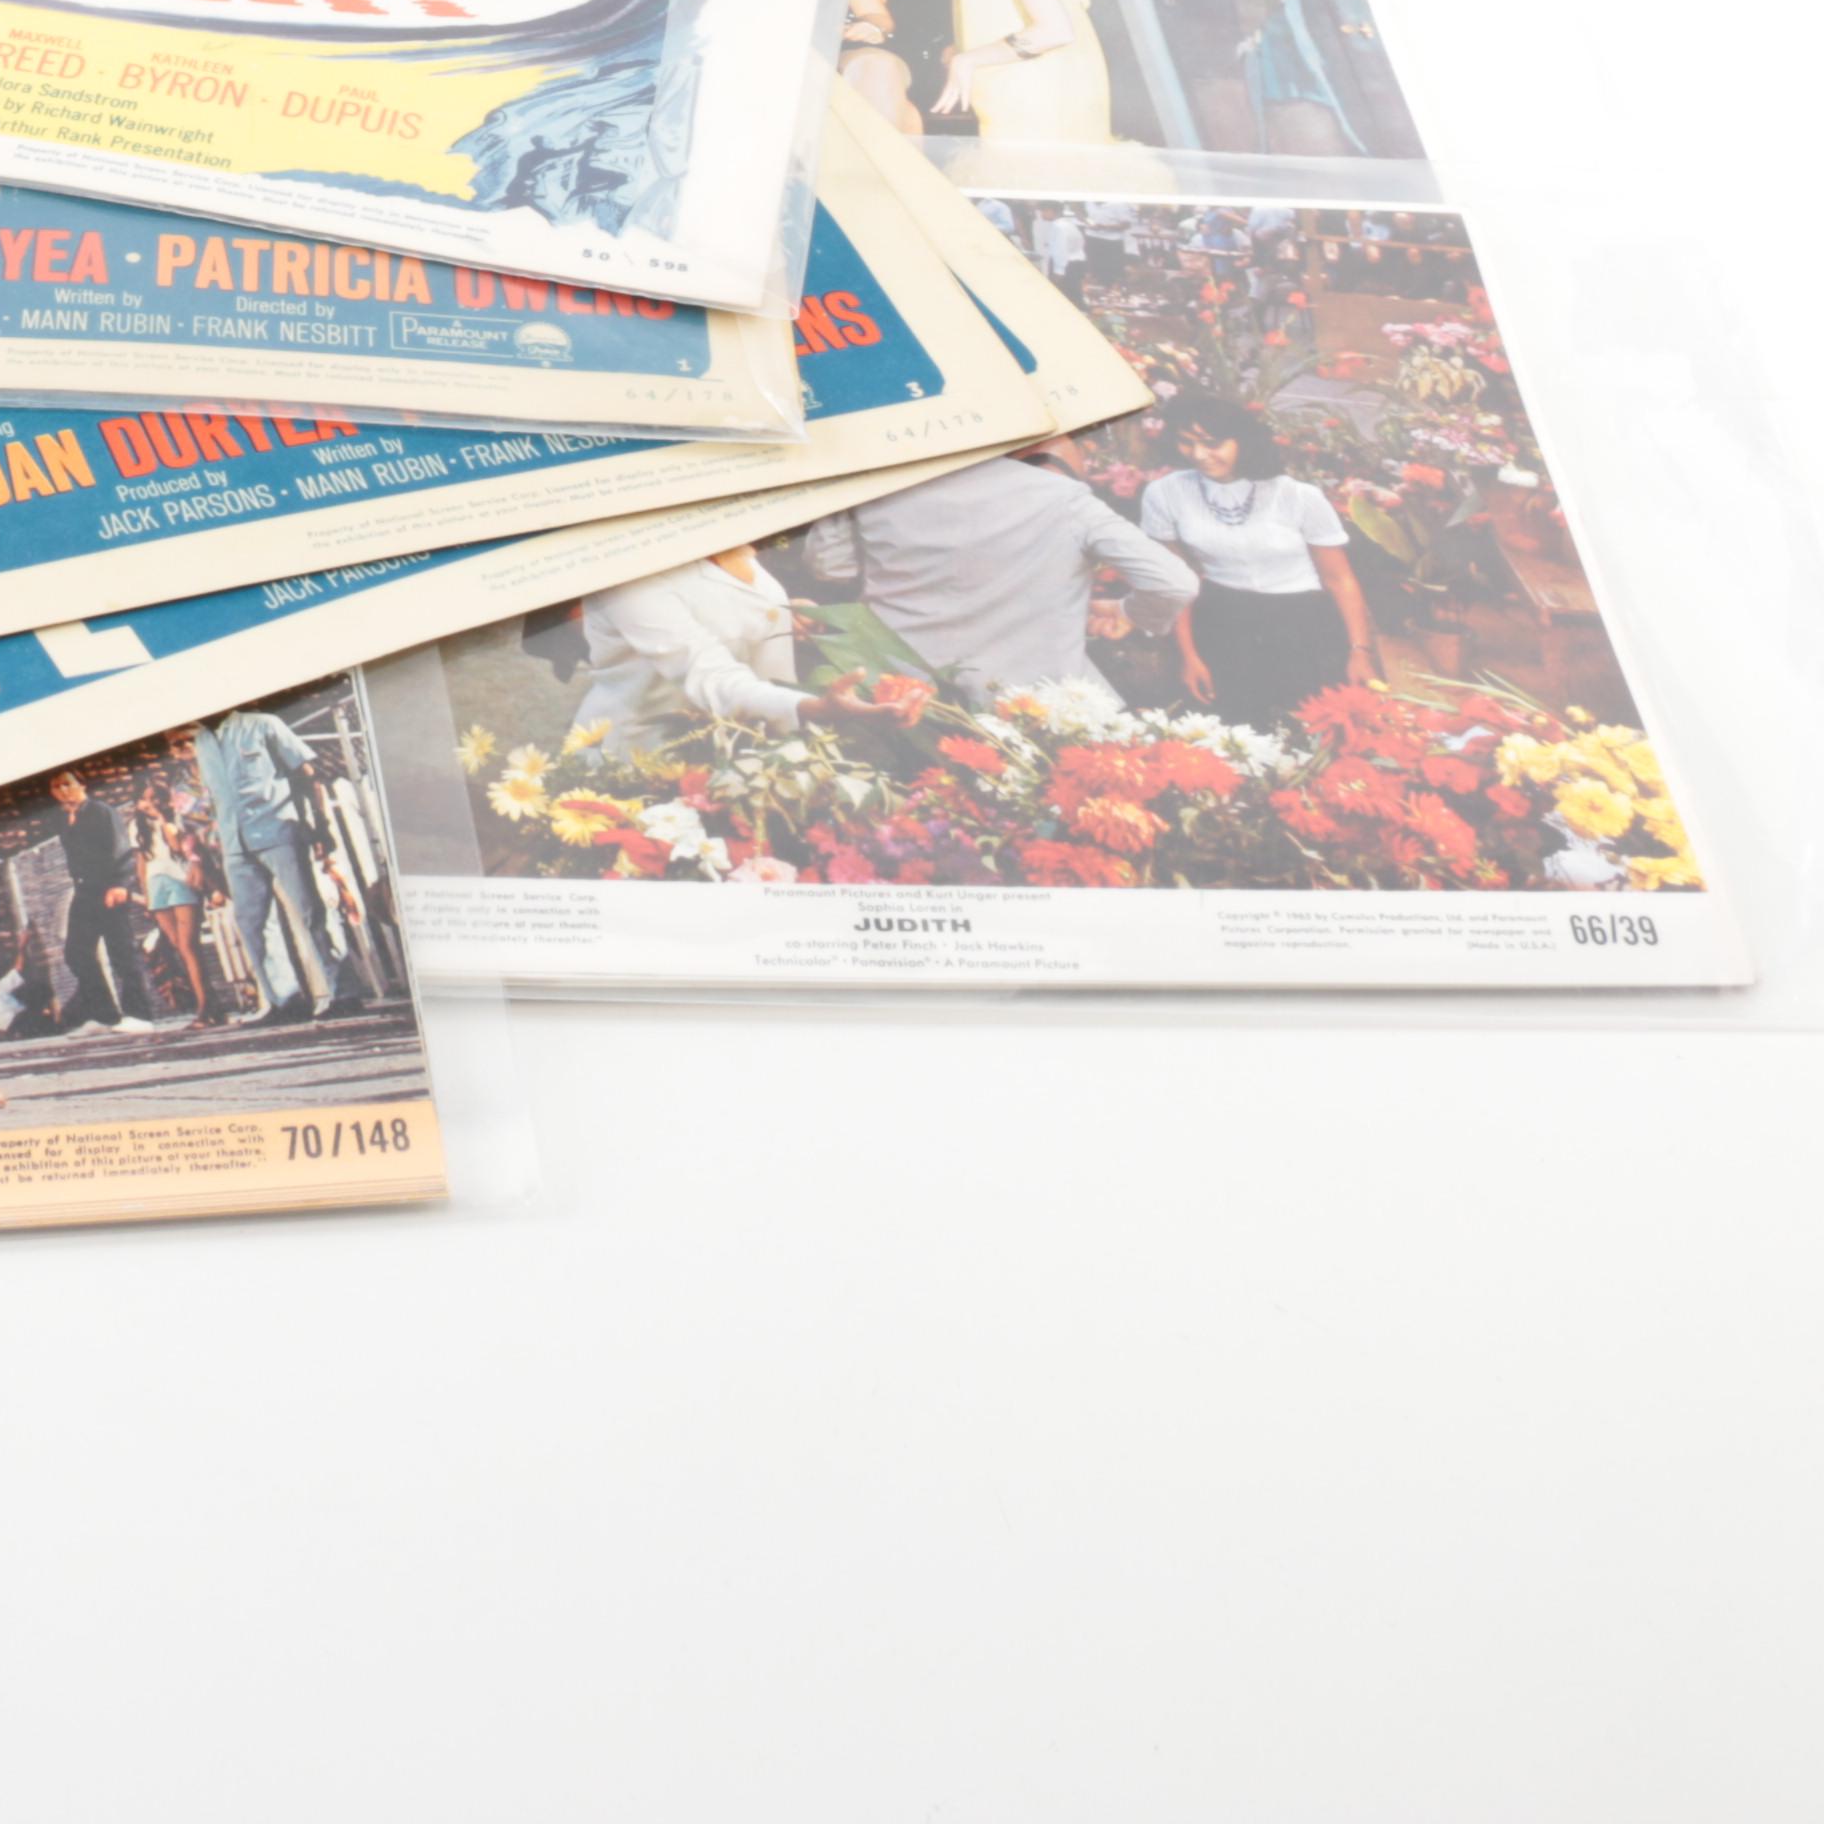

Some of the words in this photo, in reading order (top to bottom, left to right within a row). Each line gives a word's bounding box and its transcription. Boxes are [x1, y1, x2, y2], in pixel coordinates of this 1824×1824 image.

[8, 29, 84, 49] MAXWELL
[150, 51, 235, 76] KATHLEEN
[40, 81, 139, 112] Sandstrom
[118, 63, 250, 109] BYRON
[337, 83, 381, 103] PAUL
[1, 95, 26, 115] by
[30, 100, 102, 126] Richard
[107, 113, 214, 146] Wainwright
[281, 91, 424, 141] DUPUIS
[56, 126, 102, 147] Rank
[110, 135, 233, 169] Presentation
[156, 233, 432, 305] PATRICIA
[54, 286, 116, 306] Written
[121, 289, 142, 309] by
[235, 295, 310, 316] Directed
[313, 301, 335, 320] by
[20, 308, 88, 332] MANN
[99, 310, 171, 335] RUBIN
[192, 314, 269, 341] FRANK
[279, 319, 378, 348] NESBITT
[401, 314, 509, 344] PARAMOUNT
[426, 336, 488, 351] RELEASE
[906, 381, 924, 398] 3
[313, 440, 377, 467] Written
[381, 436, 404, 457] by
[297, 469, 367, 501] MANN
[376, 454, 447, 486] RUBIN
[460, 436, 540, 469] FRANK
[116, 473, 201, 503] Produced
[206, 468, 228, 488] by
[99, 508, 156, 540] JACK
[168, 485, 276, 526] PARSONS
[854, 918, 972, 933] JUDITH
[1570, 913, 1659, 946] 66/39
[280, 1117, 410, 1161] 70/148
